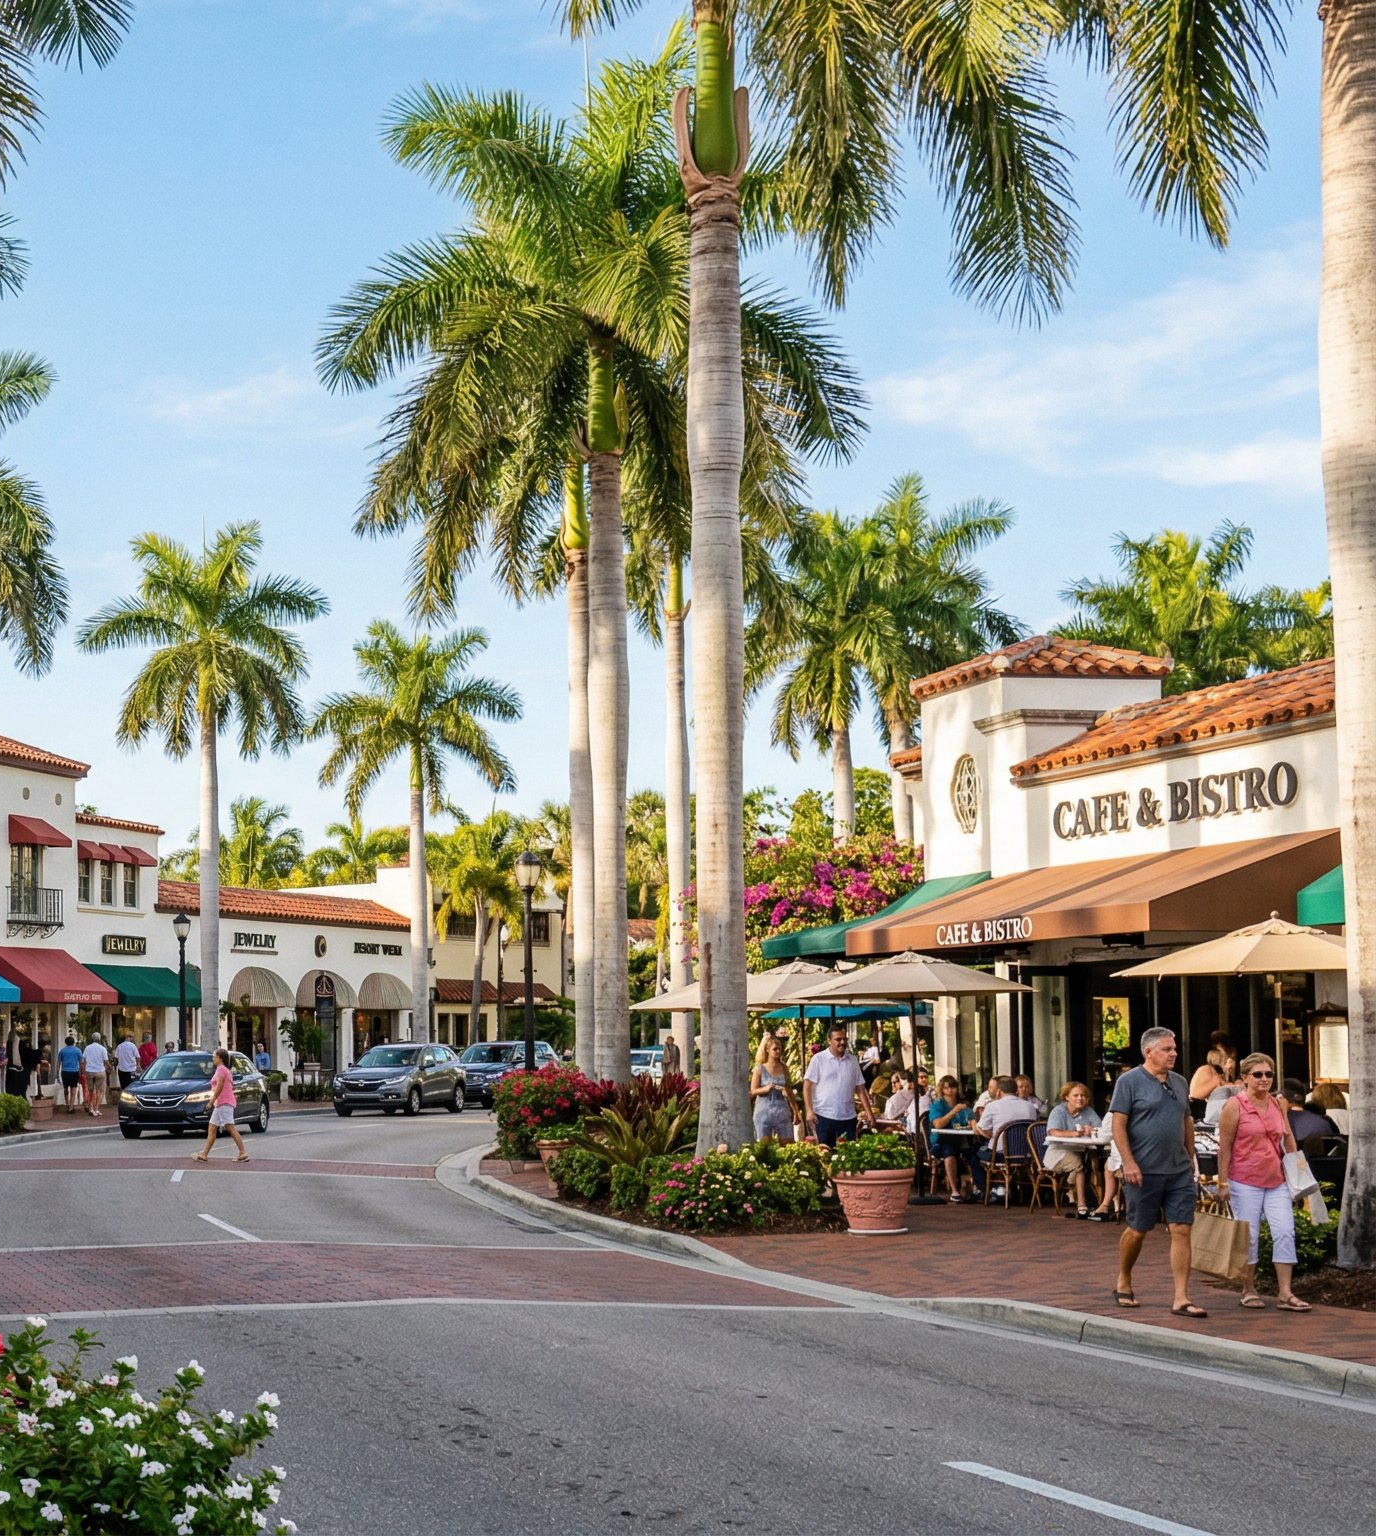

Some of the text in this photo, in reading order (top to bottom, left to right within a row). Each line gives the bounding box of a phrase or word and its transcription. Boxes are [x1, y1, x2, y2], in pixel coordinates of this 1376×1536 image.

[1053, 761, 1299, 840] CAFE & BISTRO
[936, 916, 1033, 945] CAFE & BISTRO
